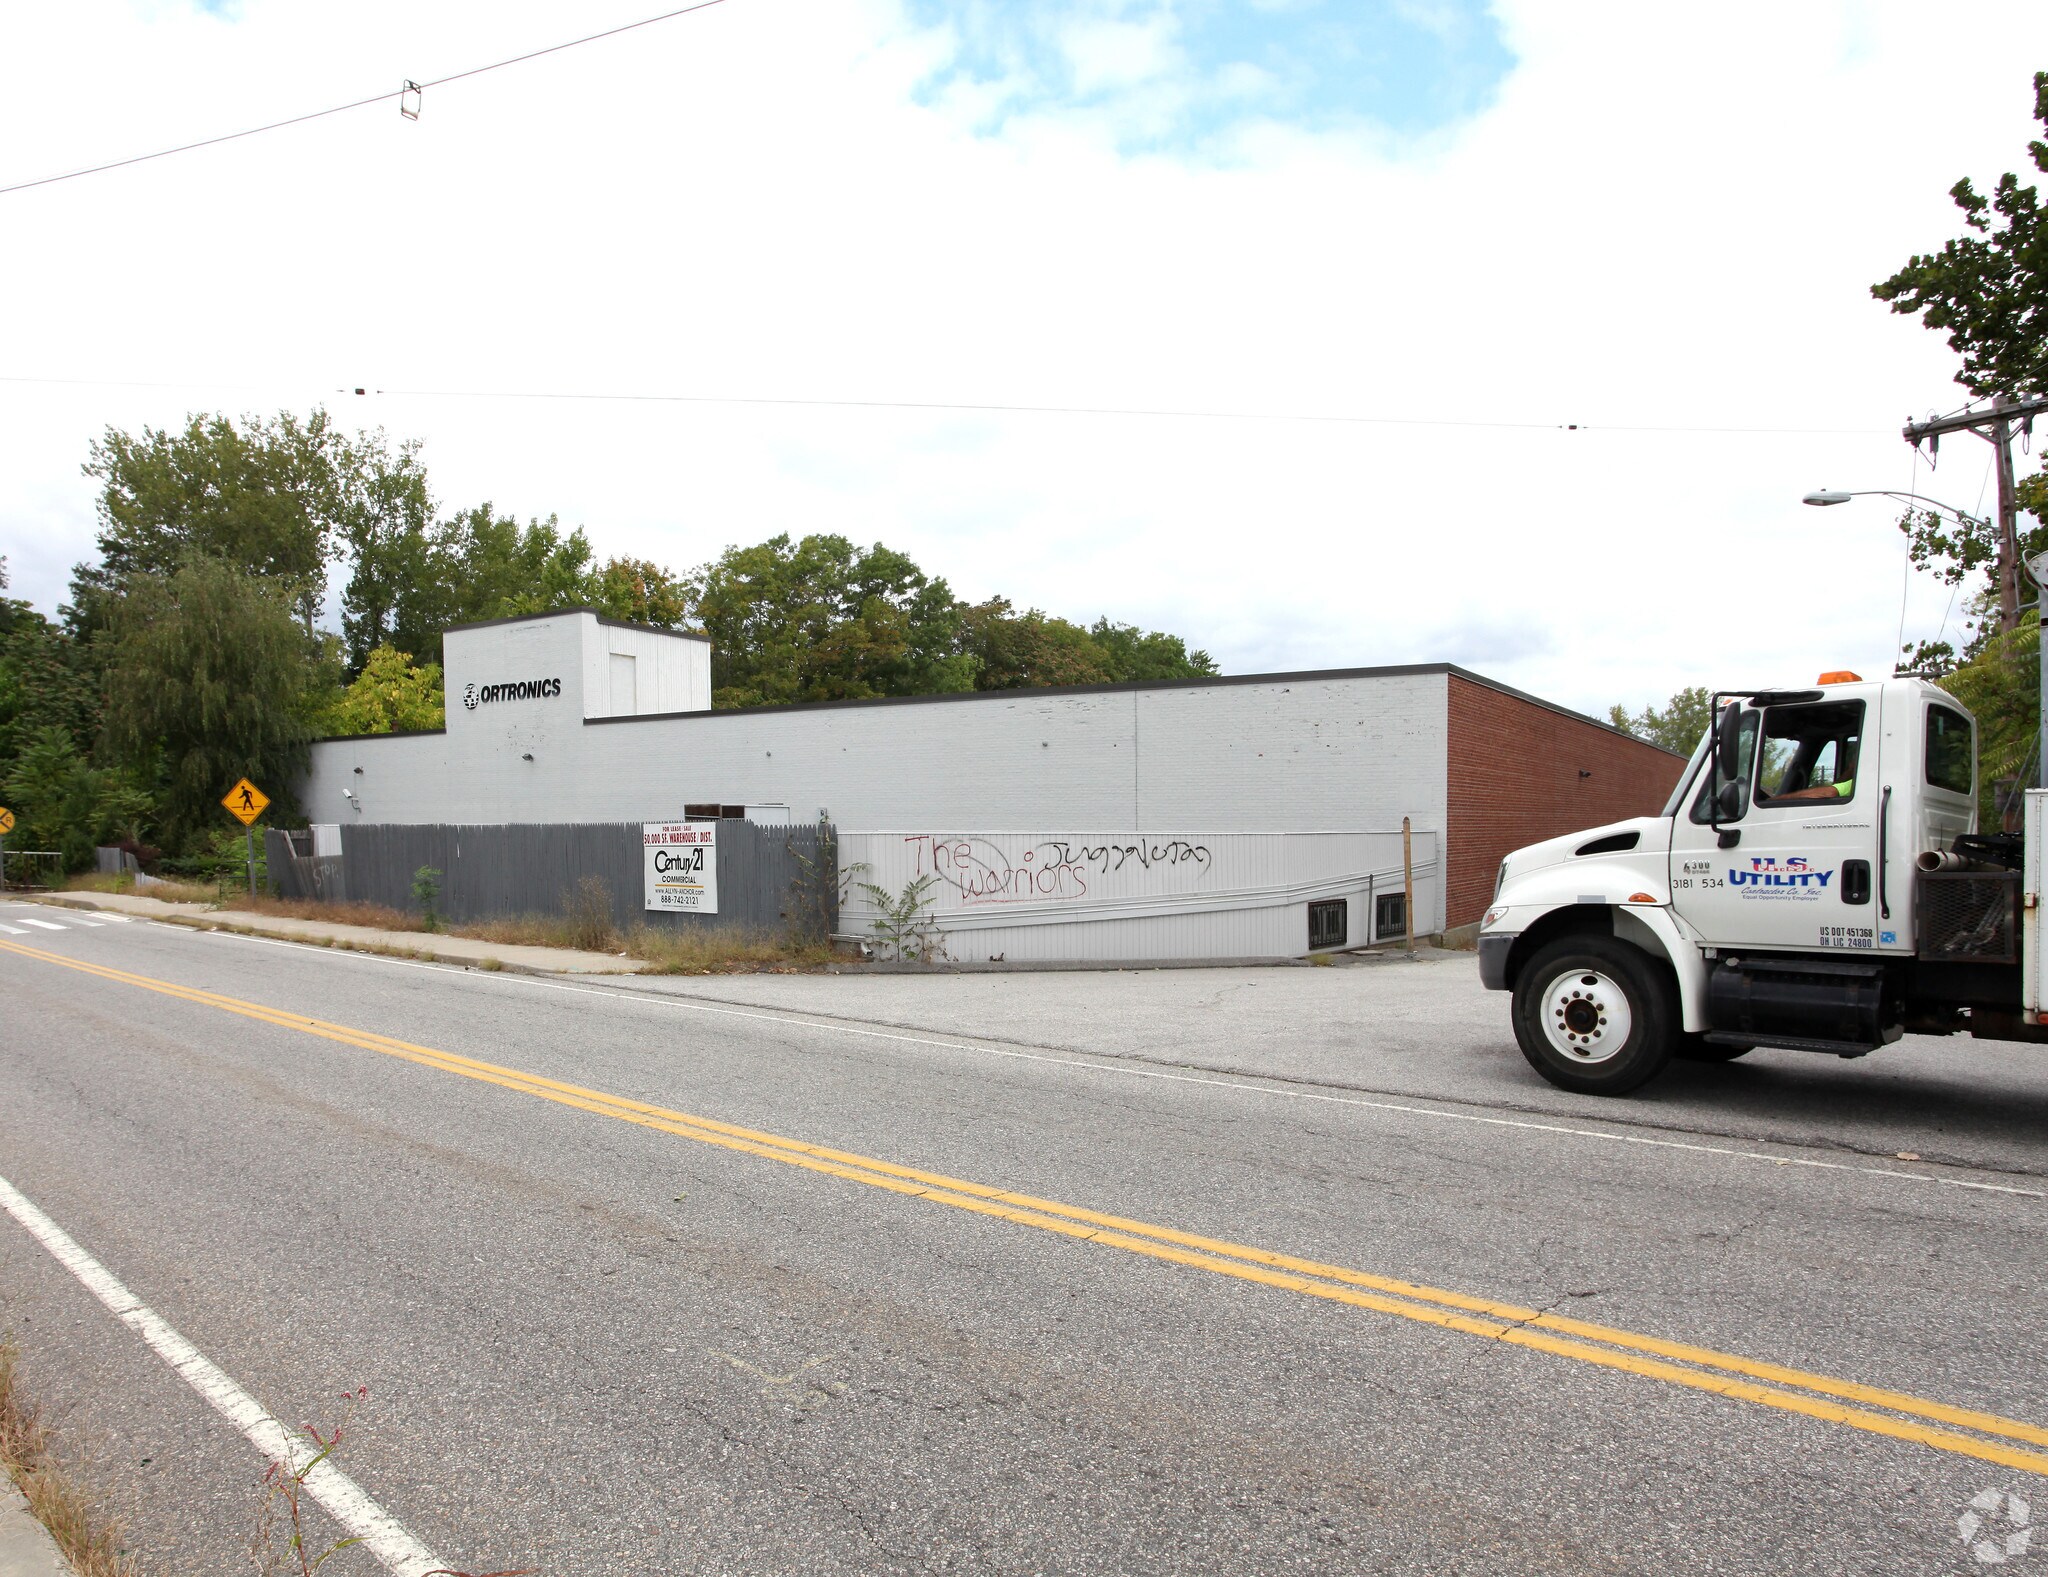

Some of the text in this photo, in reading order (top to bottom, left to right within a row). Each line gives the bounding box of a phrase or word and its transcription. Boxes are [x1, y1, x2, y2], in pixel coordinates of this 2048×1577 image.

[481, 678, 561, 703] ORTRONICS
[669, 831, 696, 843] WAREHOUSE
[700, 831, 712, 842] DIST.
[905, 836, 971, 876] The
[1750, 857, 1814, 872] U.S.
[661, 876, 697, 884] COMMERCIAL
[1673, 878, 1724, 888] 3181 534
[1729, 869, 1834, 887] UTILITY
[661, 895, 699, 904] 888-742-2121
[1820, 926, 1873, 938] US DOT 451368
[1820, 937, 1872, 948] OH LIC 24800
